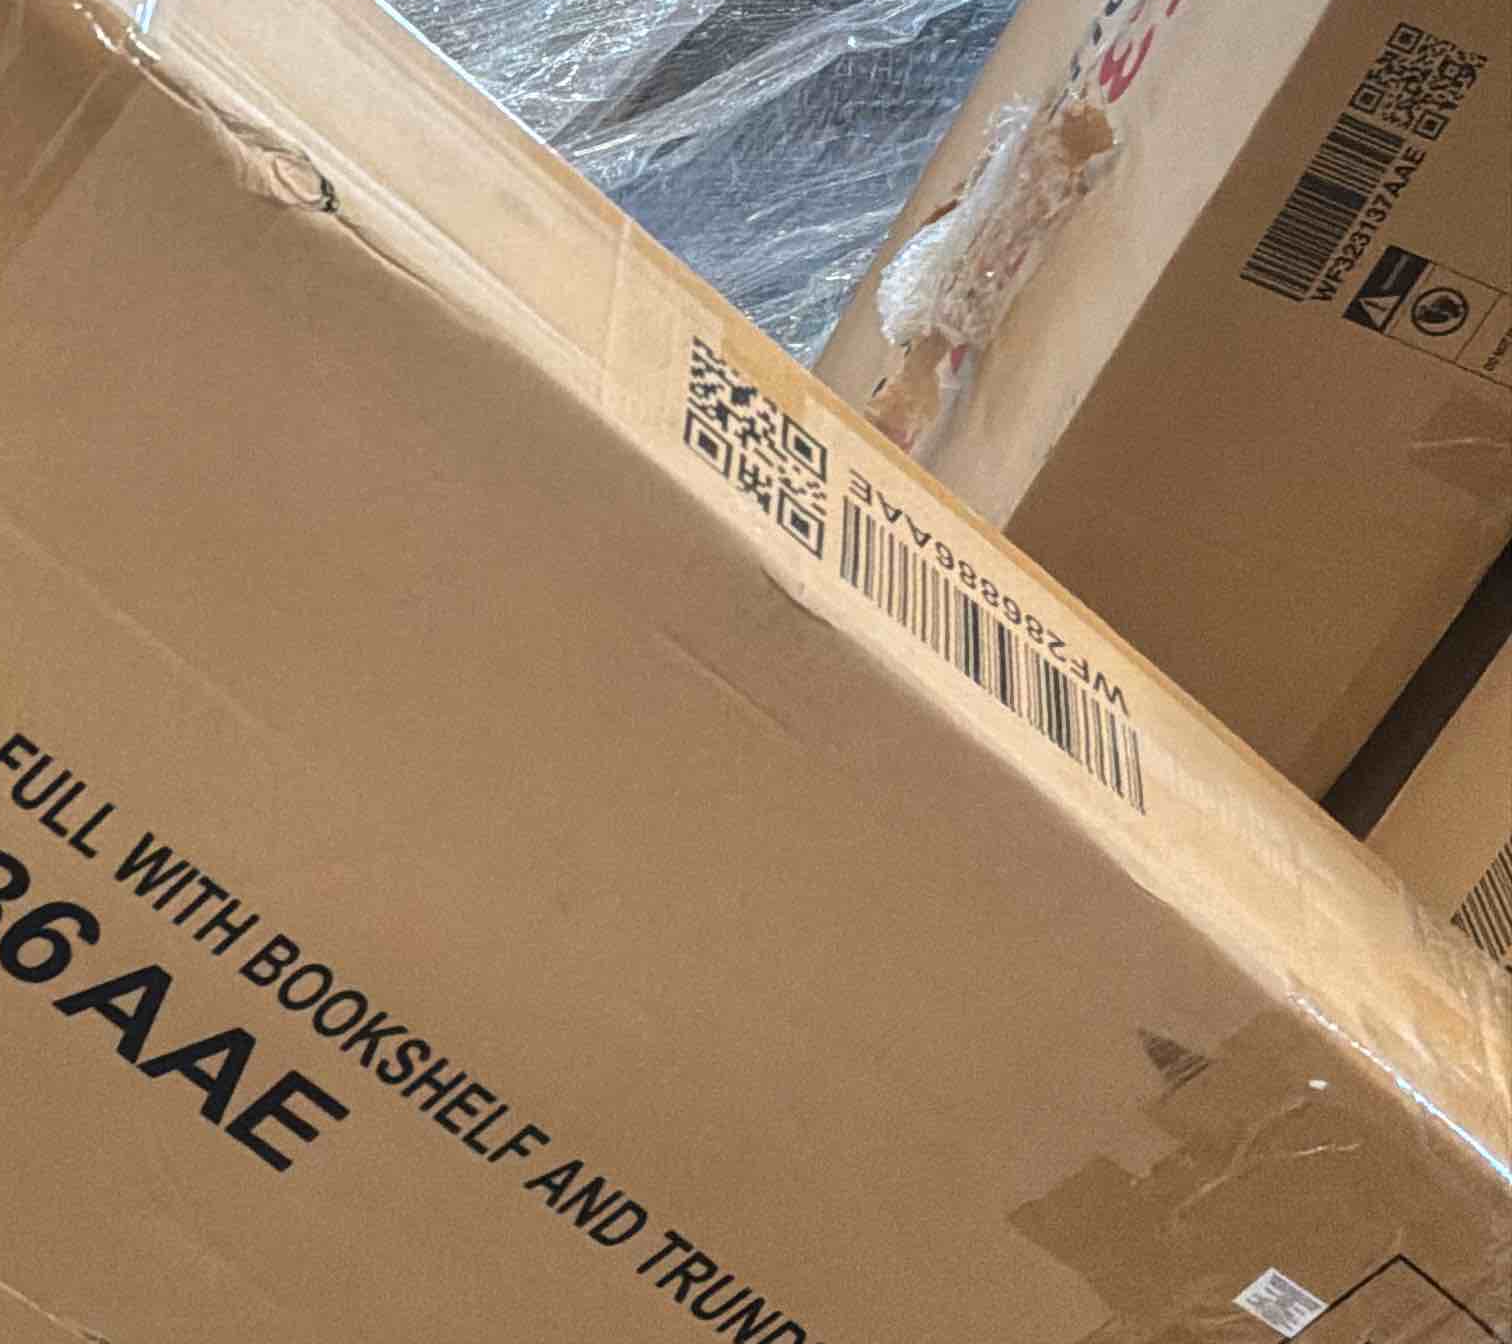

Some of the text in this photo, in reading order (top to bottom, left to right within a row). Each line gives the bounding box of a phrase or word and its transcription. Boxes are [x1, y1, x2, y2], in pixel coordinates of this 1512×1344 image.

[1311, 146, 1428, 302] WF323137AAE
[848, 467, 1131, 717] WF286886AAE
[113, 832, 260, 956] WITH
[239, 932, 551, 1165] BOOKSHELF
[523, 1158, 649, 1249] AND
